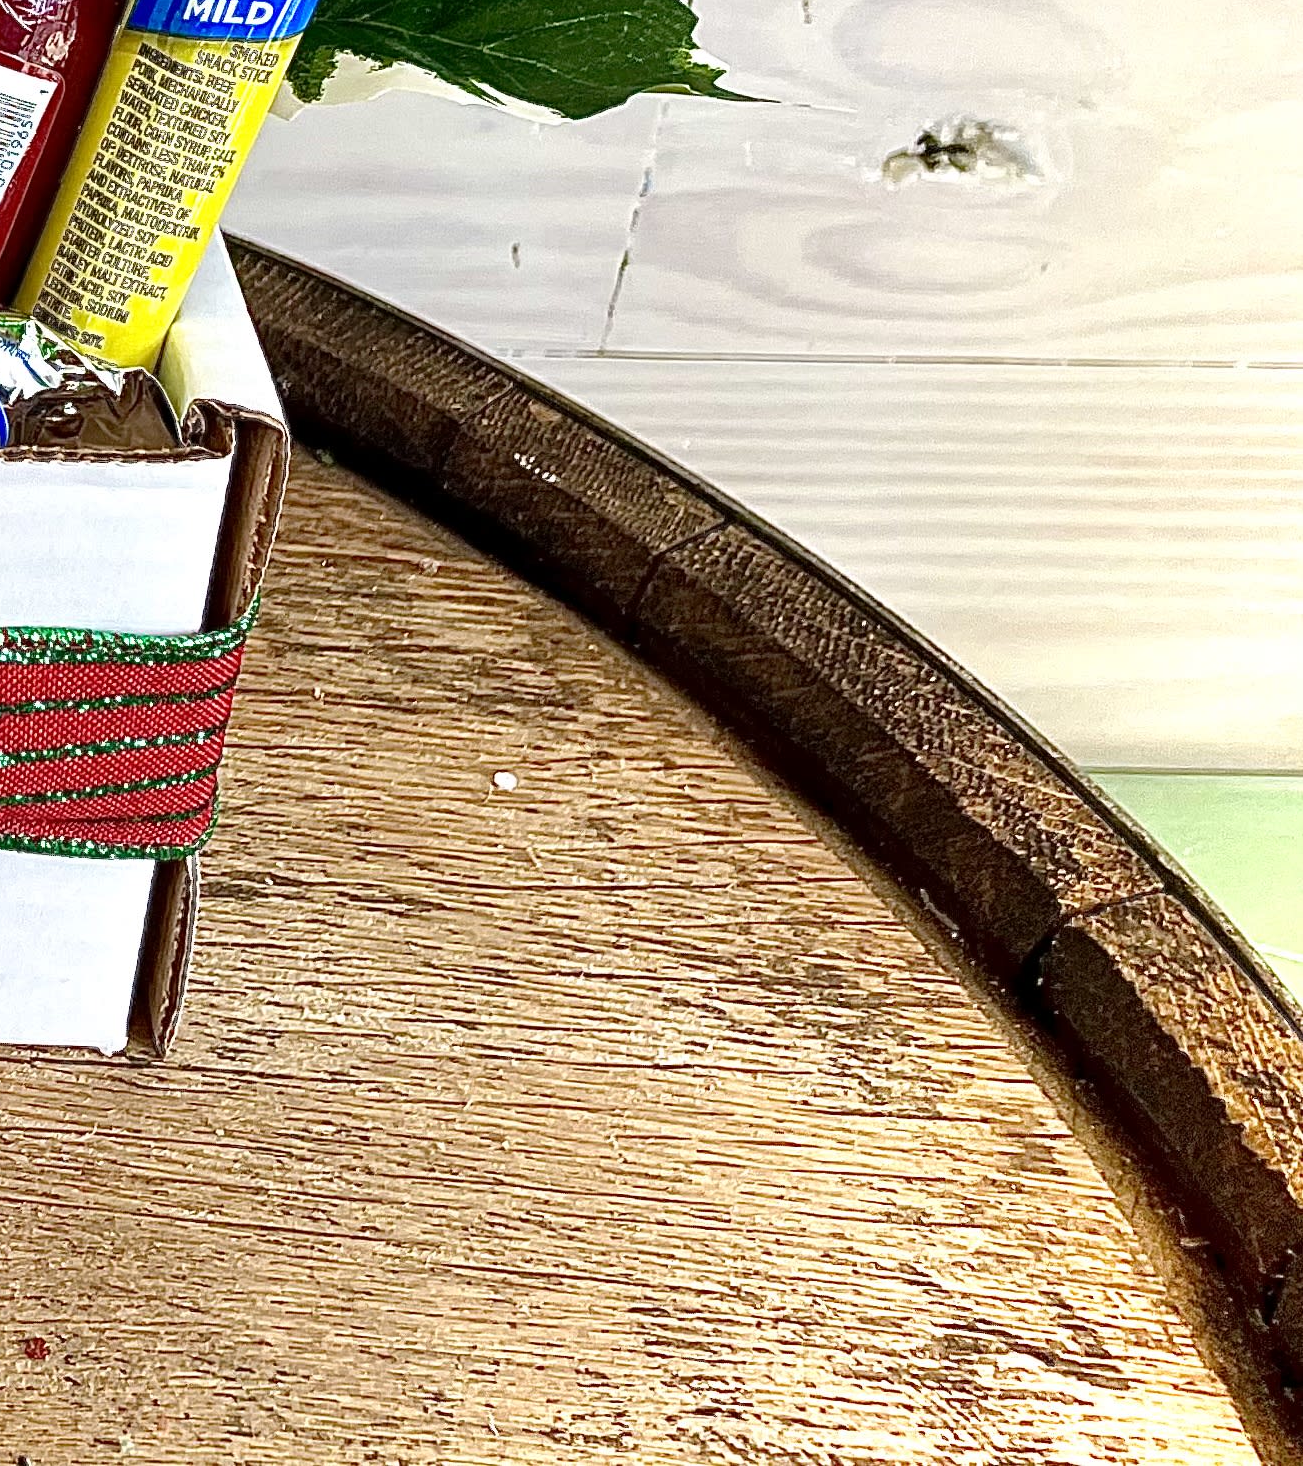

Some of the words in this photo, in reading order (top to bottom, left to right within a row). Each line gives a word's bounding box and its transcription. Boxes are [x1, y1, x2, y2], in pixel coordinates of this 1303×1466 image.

[195, 49, 240, 77] SNACK
[238, 65, 274, 83] STICK
[229, 43, 280, 67] SMOKED
[124, 73, 179, 112] SEPARATED
[157, 73, 239, 114] MECHANICALLY
[118, 89, 154, 120] WATER,
[151, 108, 208, 140] TEXTURED
[207, 128, 230, 146] SOY
[142, 123, 175, 146] CORN
[151, 145, 181, 166] LESS
[179, 155, 211, 176] THAN
[86, 167, 108, 188] AND
[105, 178, 176, 217] EXTRACTIVES
[174, 206, 192, 222] OF
[135, 175, 184, 202] PAPRIKA
[107, 235, 147, 261] LACTIC
[145, 250, 173, 268] ACID
[133, 227, 159, 247] SOY
[105, 288, 130, 307] SOY
